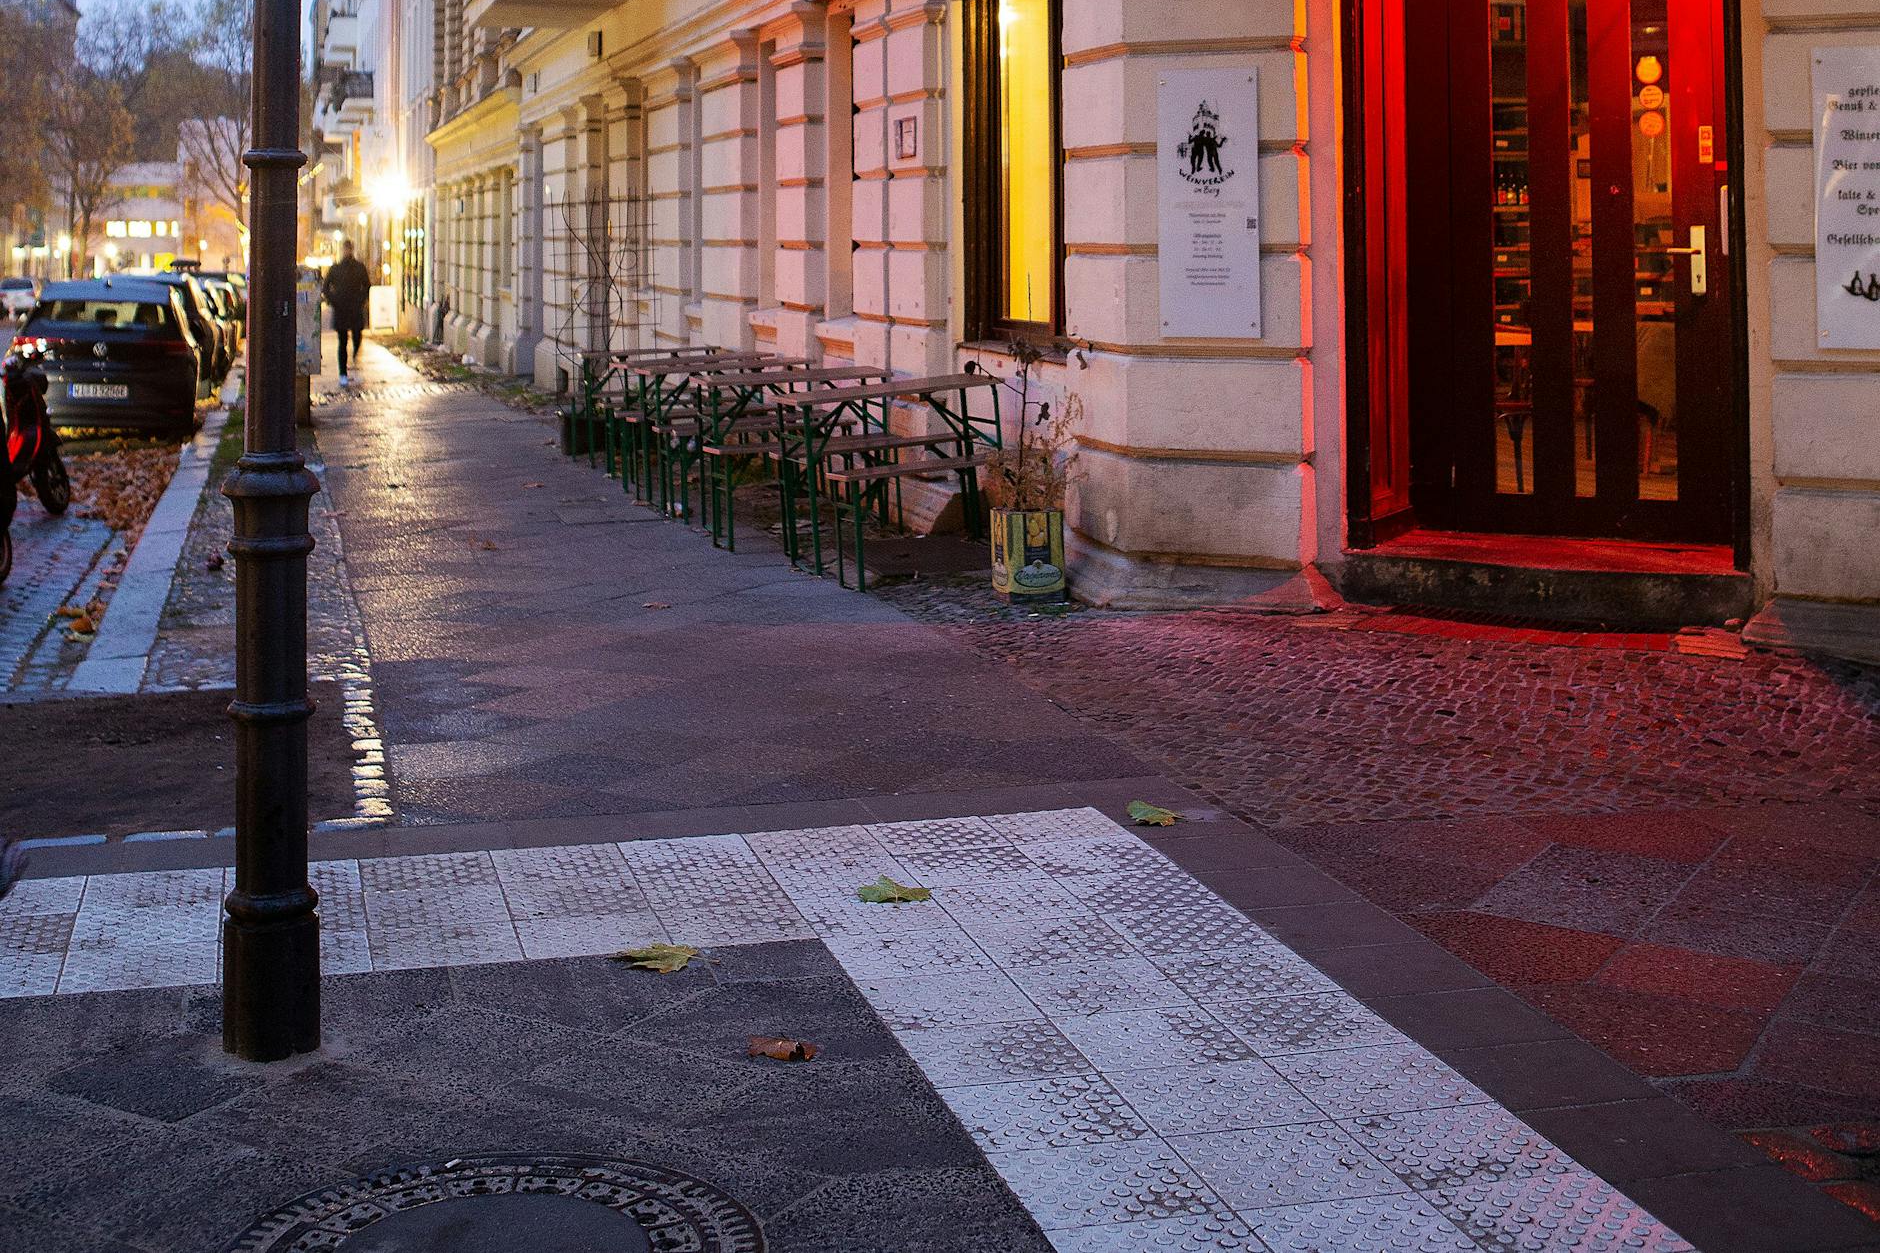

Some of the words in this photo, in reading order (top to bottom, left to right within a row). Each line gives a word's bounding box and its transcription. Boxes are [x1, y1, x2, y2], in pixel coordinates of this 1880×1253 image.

[1867, 100, 1877, 111] &
[1179, 168, 1235, 185] WEINVEREIN
[1866, 190, 1876, 200] &
